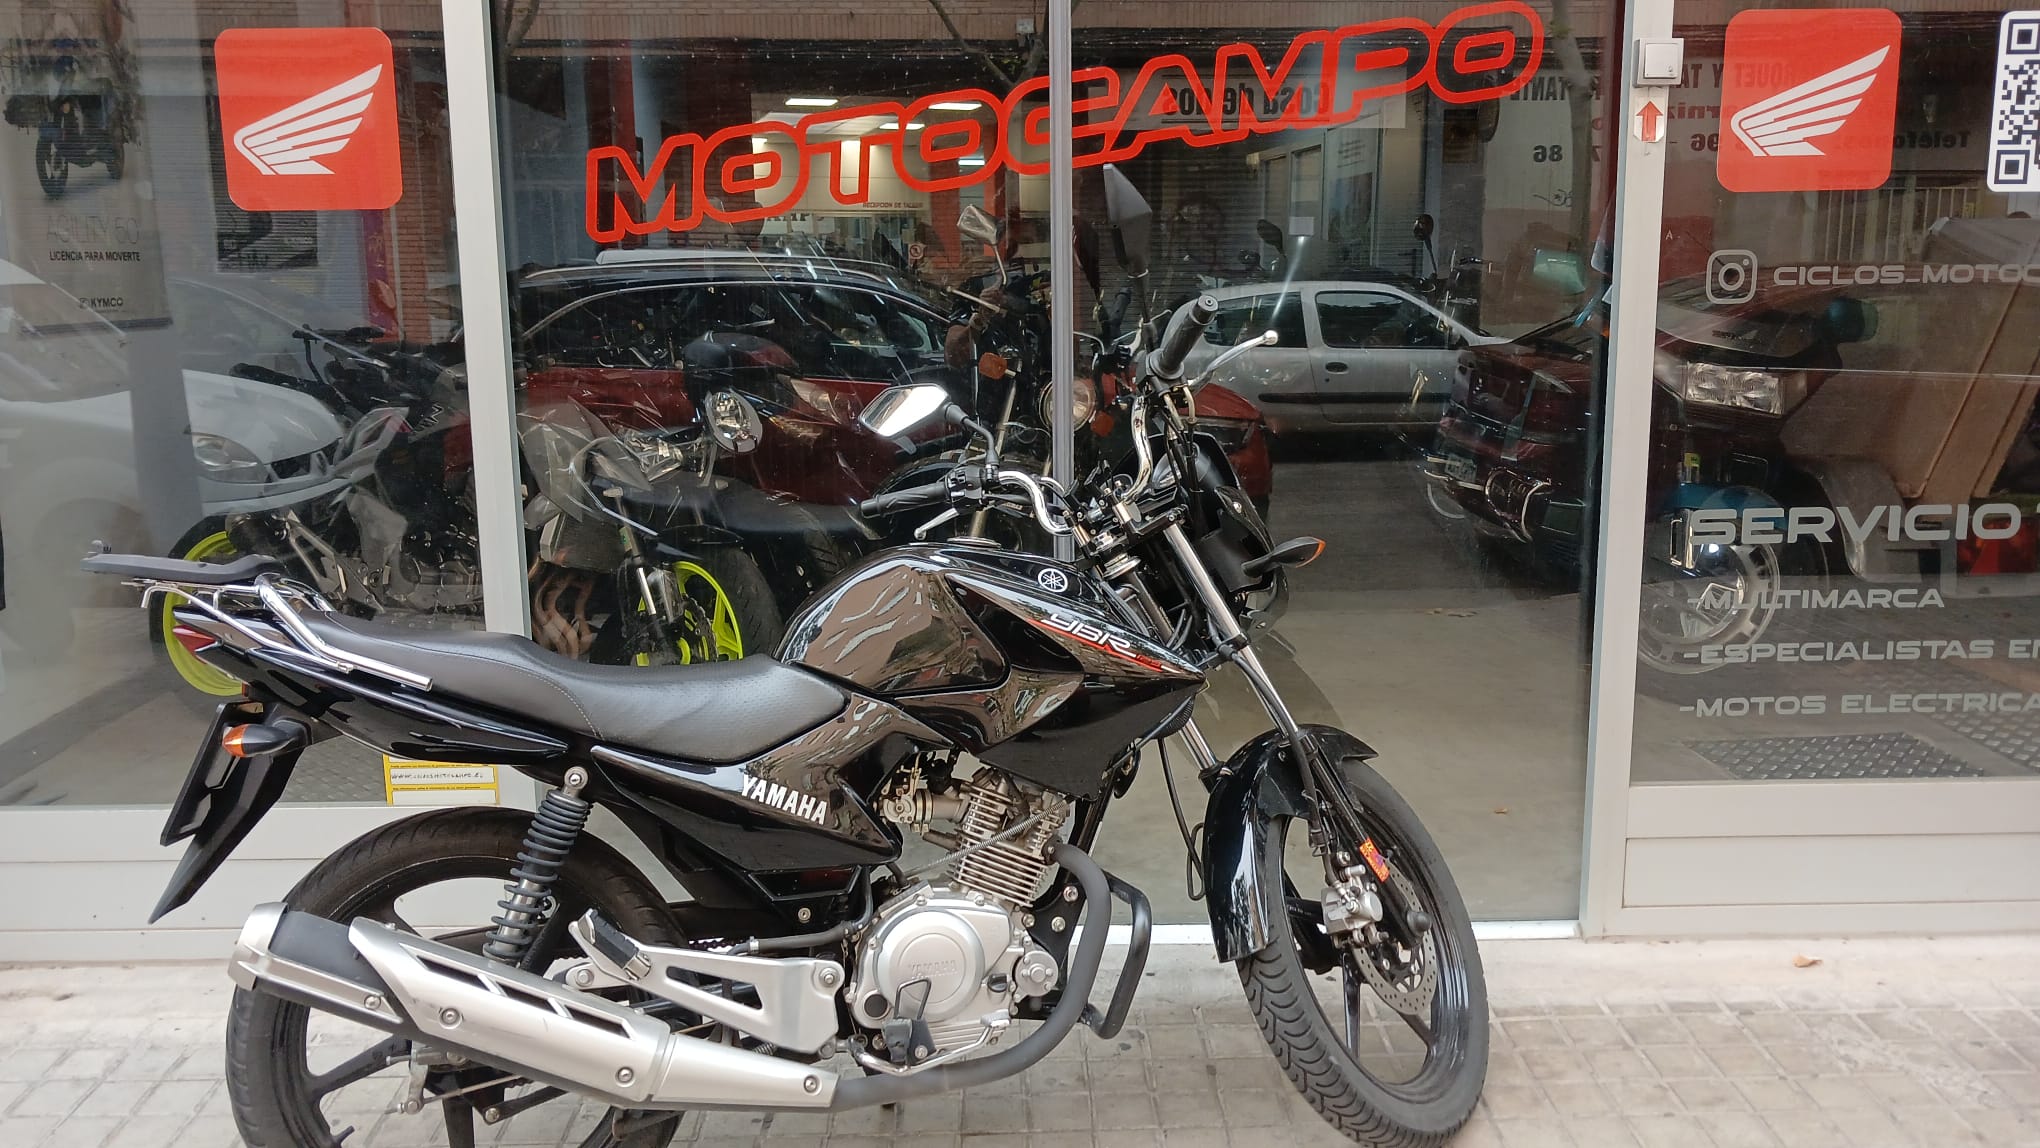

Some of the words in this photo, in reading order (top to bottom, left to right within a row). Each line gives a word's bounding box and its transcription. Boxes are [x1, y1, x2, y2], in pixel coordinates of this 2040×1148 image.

[586, 1, 1544, 242] MOTOCAMPO
[49, 251, 83, 262] LICENCIA
[84, 251, 105, 261] PARA
[105, 251, 141, 262] MOVERTE
[1773, 263, 2040, 286] CICLOS_MOTOC
[91, 297, 124, 308] KYMCO
[1690, 503, 2022, 545] SERVICIO
[1841, 693, 2040, 714] ELECTRICA
[741, 773, 828, 826] YAMAHA
